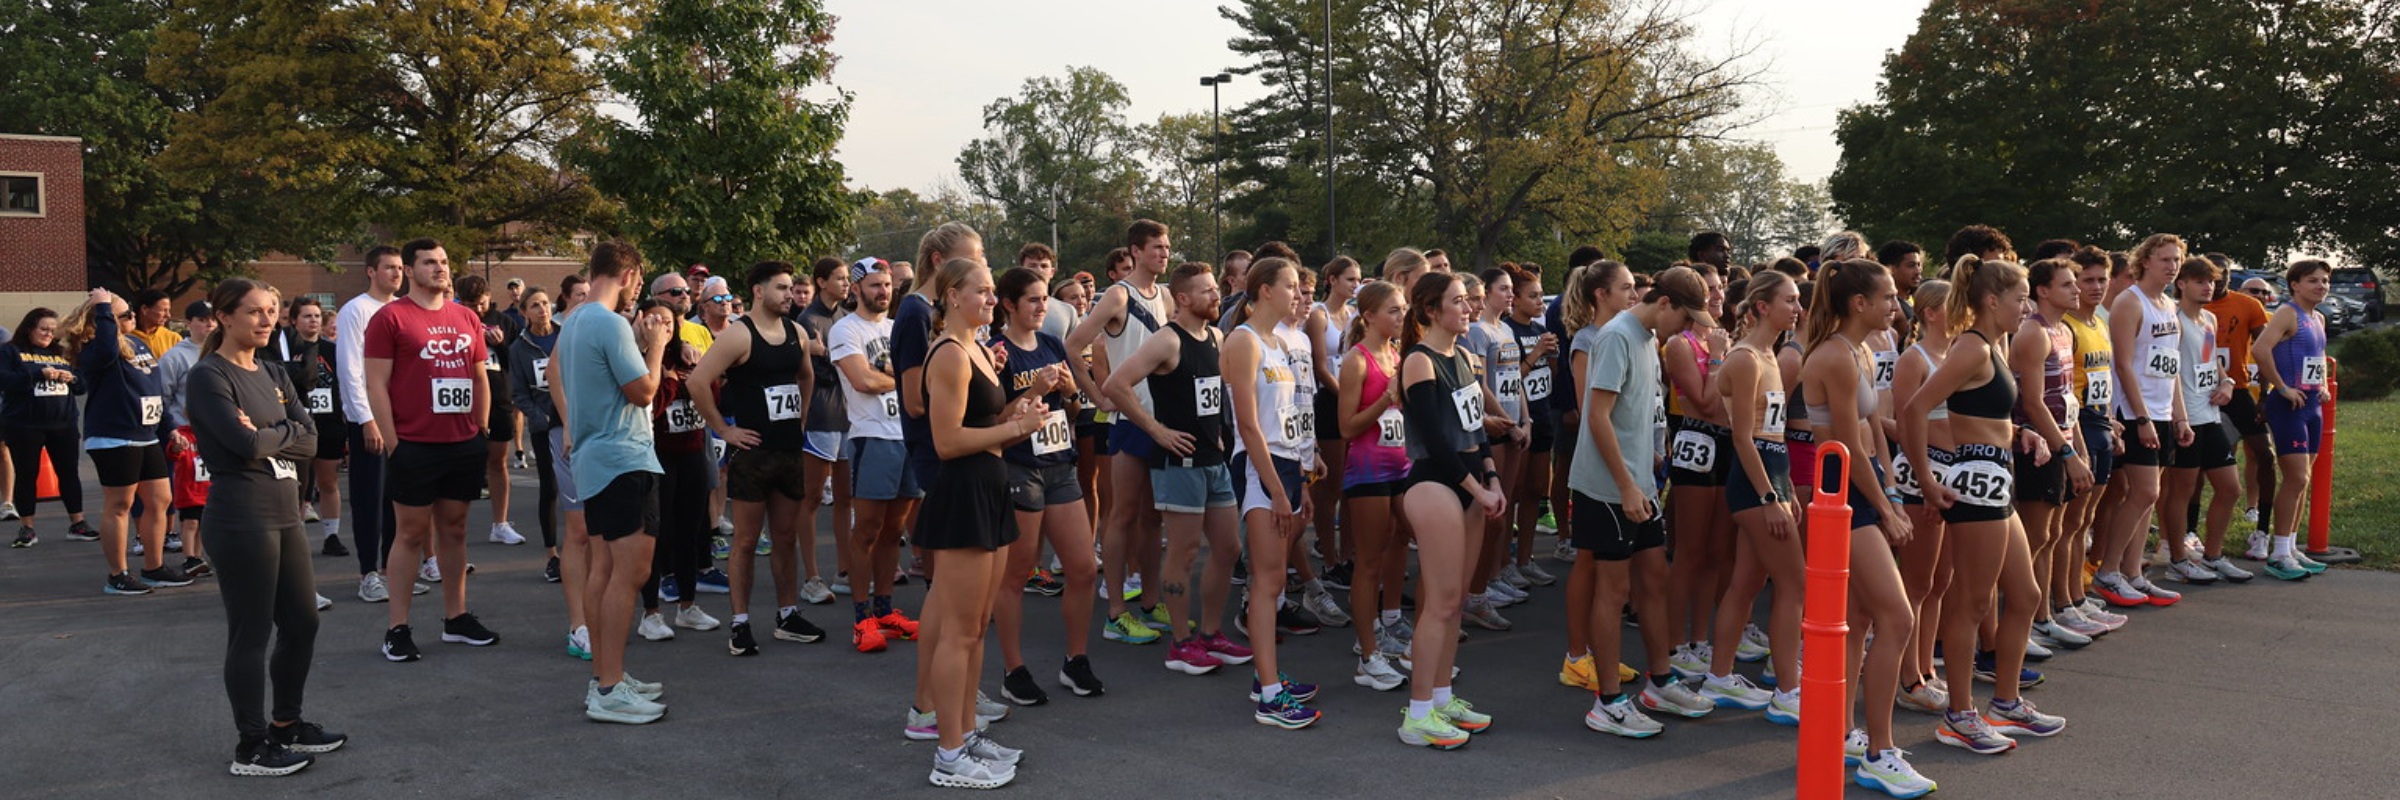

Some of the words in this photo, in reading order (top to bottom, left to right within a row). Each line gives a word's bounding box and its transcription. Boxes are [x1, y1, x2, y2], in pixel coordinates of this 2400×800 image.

[427, 326, 458, 335] SOCIAL
[434, 358, 465, 368] SPORTS
[2150, 354, 2177, 374] 488
[2307, 364, 2325, 379] 79
[1529, 374, 1550, 395] 231
[437, 388, 471, 407] 686
[1036, 420, 1067, 446] 406
[1963, 443, 1996, 457] PRO
[1952, 470, 2006, 500] 452
